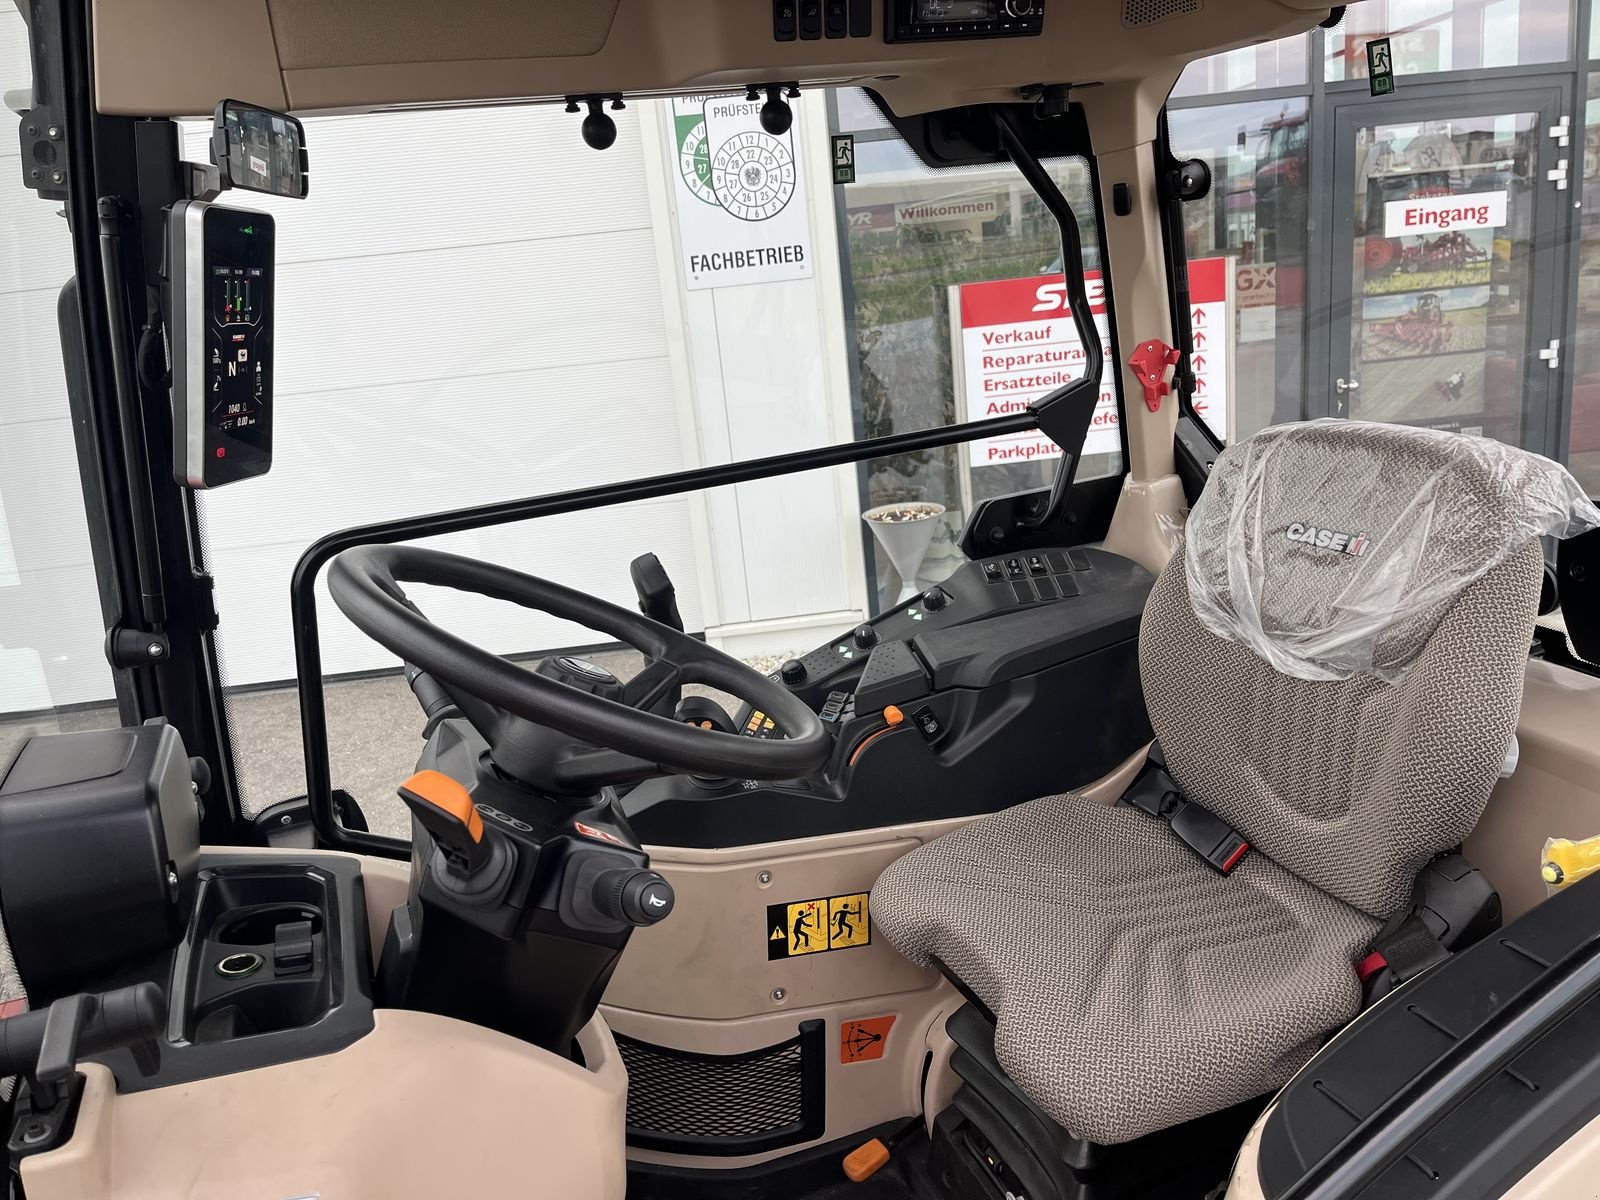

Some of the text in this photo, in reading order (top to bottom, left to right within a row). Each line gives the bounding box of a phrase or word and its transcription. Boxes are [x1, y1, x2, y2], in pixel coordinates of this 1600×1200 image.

[745, 135, 755, 145] 12
[729, 141, 737, 152] 11
[746, 150, 755, 160] 22
[730, 160, 740, 170] 28
[769, 174, 779, 184] 24
[729, 180, 739, 190] 27
[742, 193, 752, 204] 26
[760, 191, 770, 202] 25
[899, 202, 994, 220] Willkommen
[1405, 205, 1489, 228] Eingang
[691, 245, 804, 272] FACHBETRIEB
[982, 326, 1052, 345] Verkauf
[228, 361, 237, 377] N
[984, 372, 1072, 392] Ersatzteile
